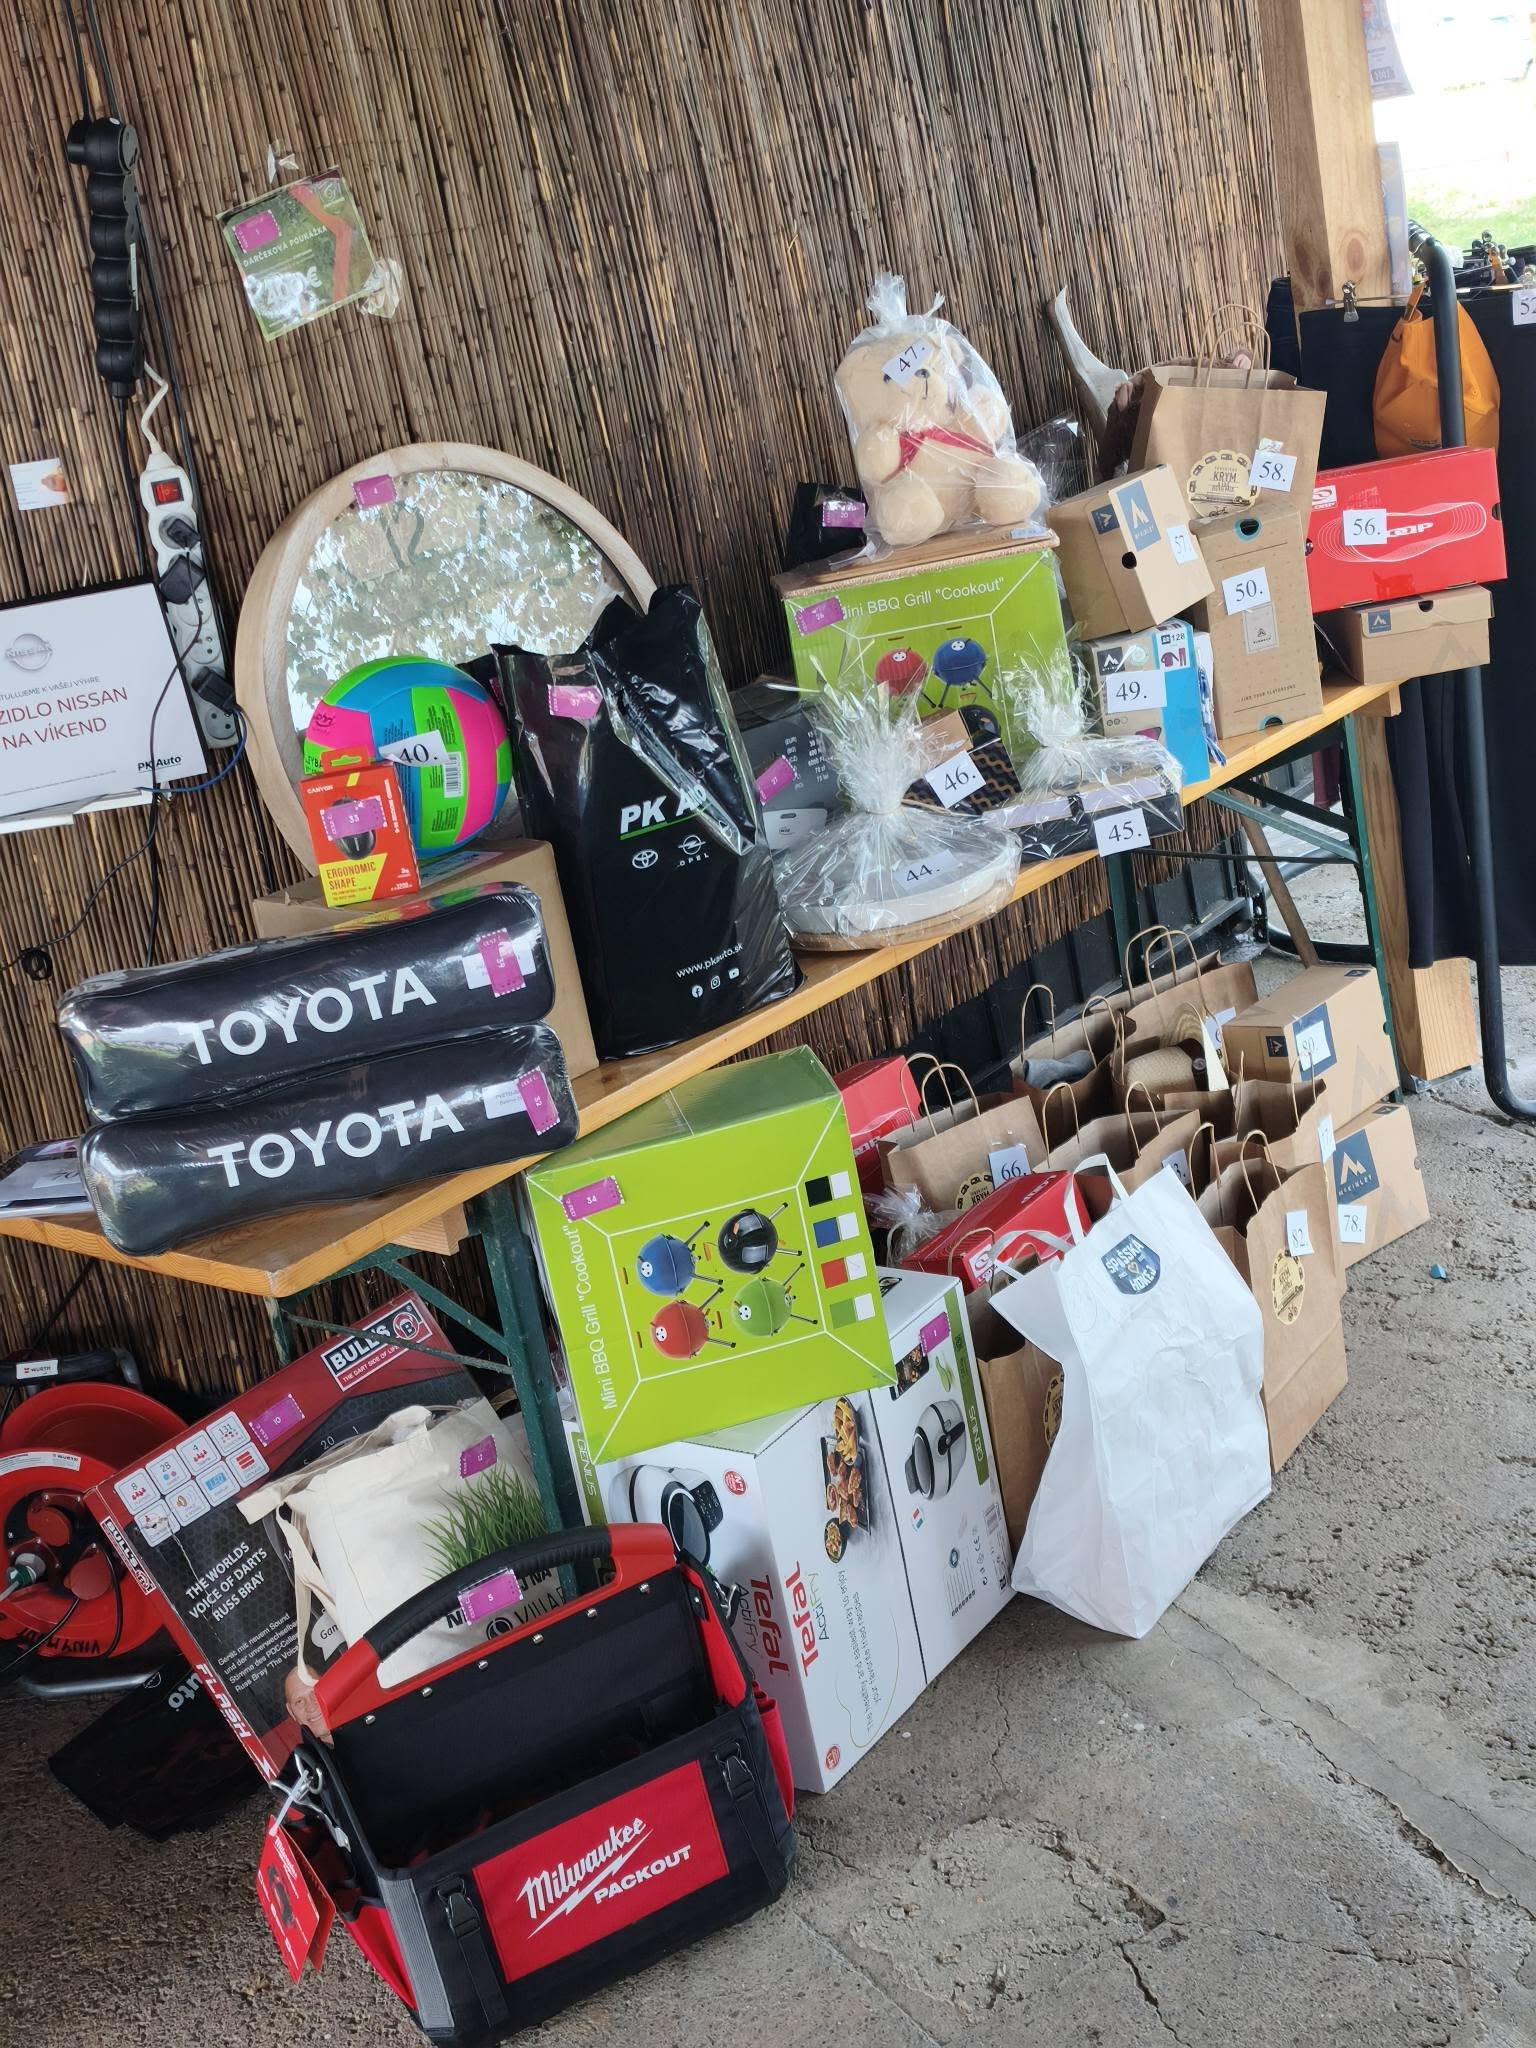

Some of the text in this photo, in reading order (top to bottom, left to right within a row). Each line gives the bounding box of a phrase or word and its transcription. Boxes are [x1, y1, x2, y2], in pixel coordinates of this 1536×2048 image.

[899, 345, 925, 372] 47.
[1213, 472, 1237, 482] KRYM
[1259, 461, 1286, 482] 58.
[1353, 518, 1381, 536] 56.
[867, 596, 901, 616] BBQ
[904, 590, 932, 608] Grill
[935, 577, 1005, 602] "Cookout"
[1235, 579, 1263, 602] 50.
[1171, 633, 1186, 641] 128
[57, 686, 128, 713] NISSAN
[1115, 681, 1148, 702] 49.
[2, 717, 108, 750] NA VÍKEND
[156, 755, 182, 768] Auto
[943, 767, 976, 792] 46.
[620, 796, 667, 834] PK
[1108, 820, 1142, 842] 45.
[326, 862, 376, 879] ERGONOMIC
[679, 852, 709, 867] OPEL
[906, 863, 940, 882] 44.
[329, 877, 357, 890] SHAPE
[676, 942, 744, 978] www.pkauto.sk
[190, 966, 437, 1065] TOYOTA
[207, 1094, 465, 1188] TOYOTA
[1001, 1159, 1027, 1181] 66.
[1343, 1214, 1362, 1233] 78.
[562, 1224, 592, 1302] "Cookout"
[581, 1303, 601, 1336] Grill
[343, 1374, 354, 1382] THE
[353, 1363, 368, 1377] DART
[368, 1356, 381, 1367] SIDE
[589, 1337, 610, 1376] BBQ
[598, 1378, 618, 1411] Mini
[218, 1423, 233, 1435] 131
[968, 1404, 984, 1463] GENIUS
[320, 1436, 335, 1450] 20
[160, 1461, 172, 1473] 28
[577, 1438, 597, 1496] GENIUS
[185, 1542, 250, 1601] THE WORLDS
[188, 1548, 268, 1620] VOICE OF DARTS
[212, 1571, 266, 1622] RUSS BRAY
[269, 1612, 291, 1630] Sound
[750, 1573, 791, 1676] Tefal
[785, 1560, 820, 1678] Tefal
[224, 1661, 237, 1675] und
[236, 1654, 248, 1668] der
[251, 1667, 269, 1682] Bray
[254, 1655, 267, 1668] des
[168, 1671, 204, 1709] uto
[196, 1663, 252, 1737] FLASH
[515, 1816, 647, 1919] Milwaukee
[593, 1844, 691, 1905] PACKOUT
